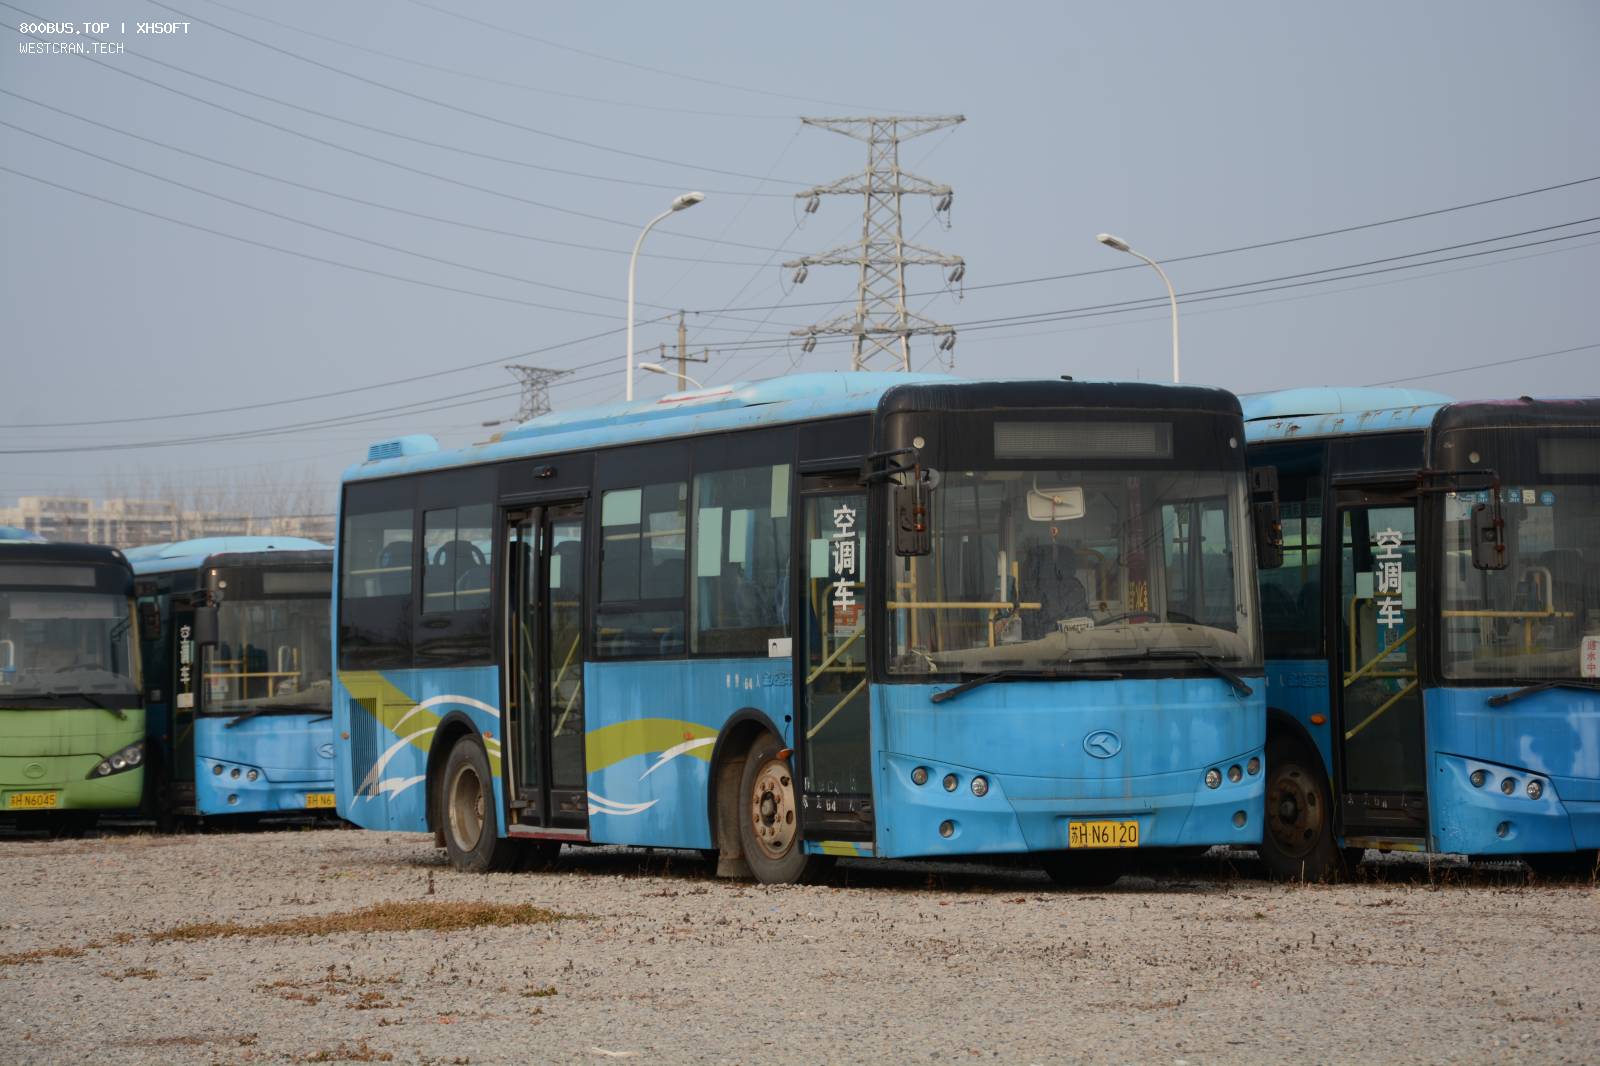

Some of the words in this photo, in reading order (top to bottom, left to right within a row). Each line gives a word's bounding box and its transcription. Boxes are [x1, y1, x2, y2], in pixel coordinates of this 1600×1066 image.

[832, 504, 856, 612] 空调车
[1375, 527, 1404, 629] 空调车
